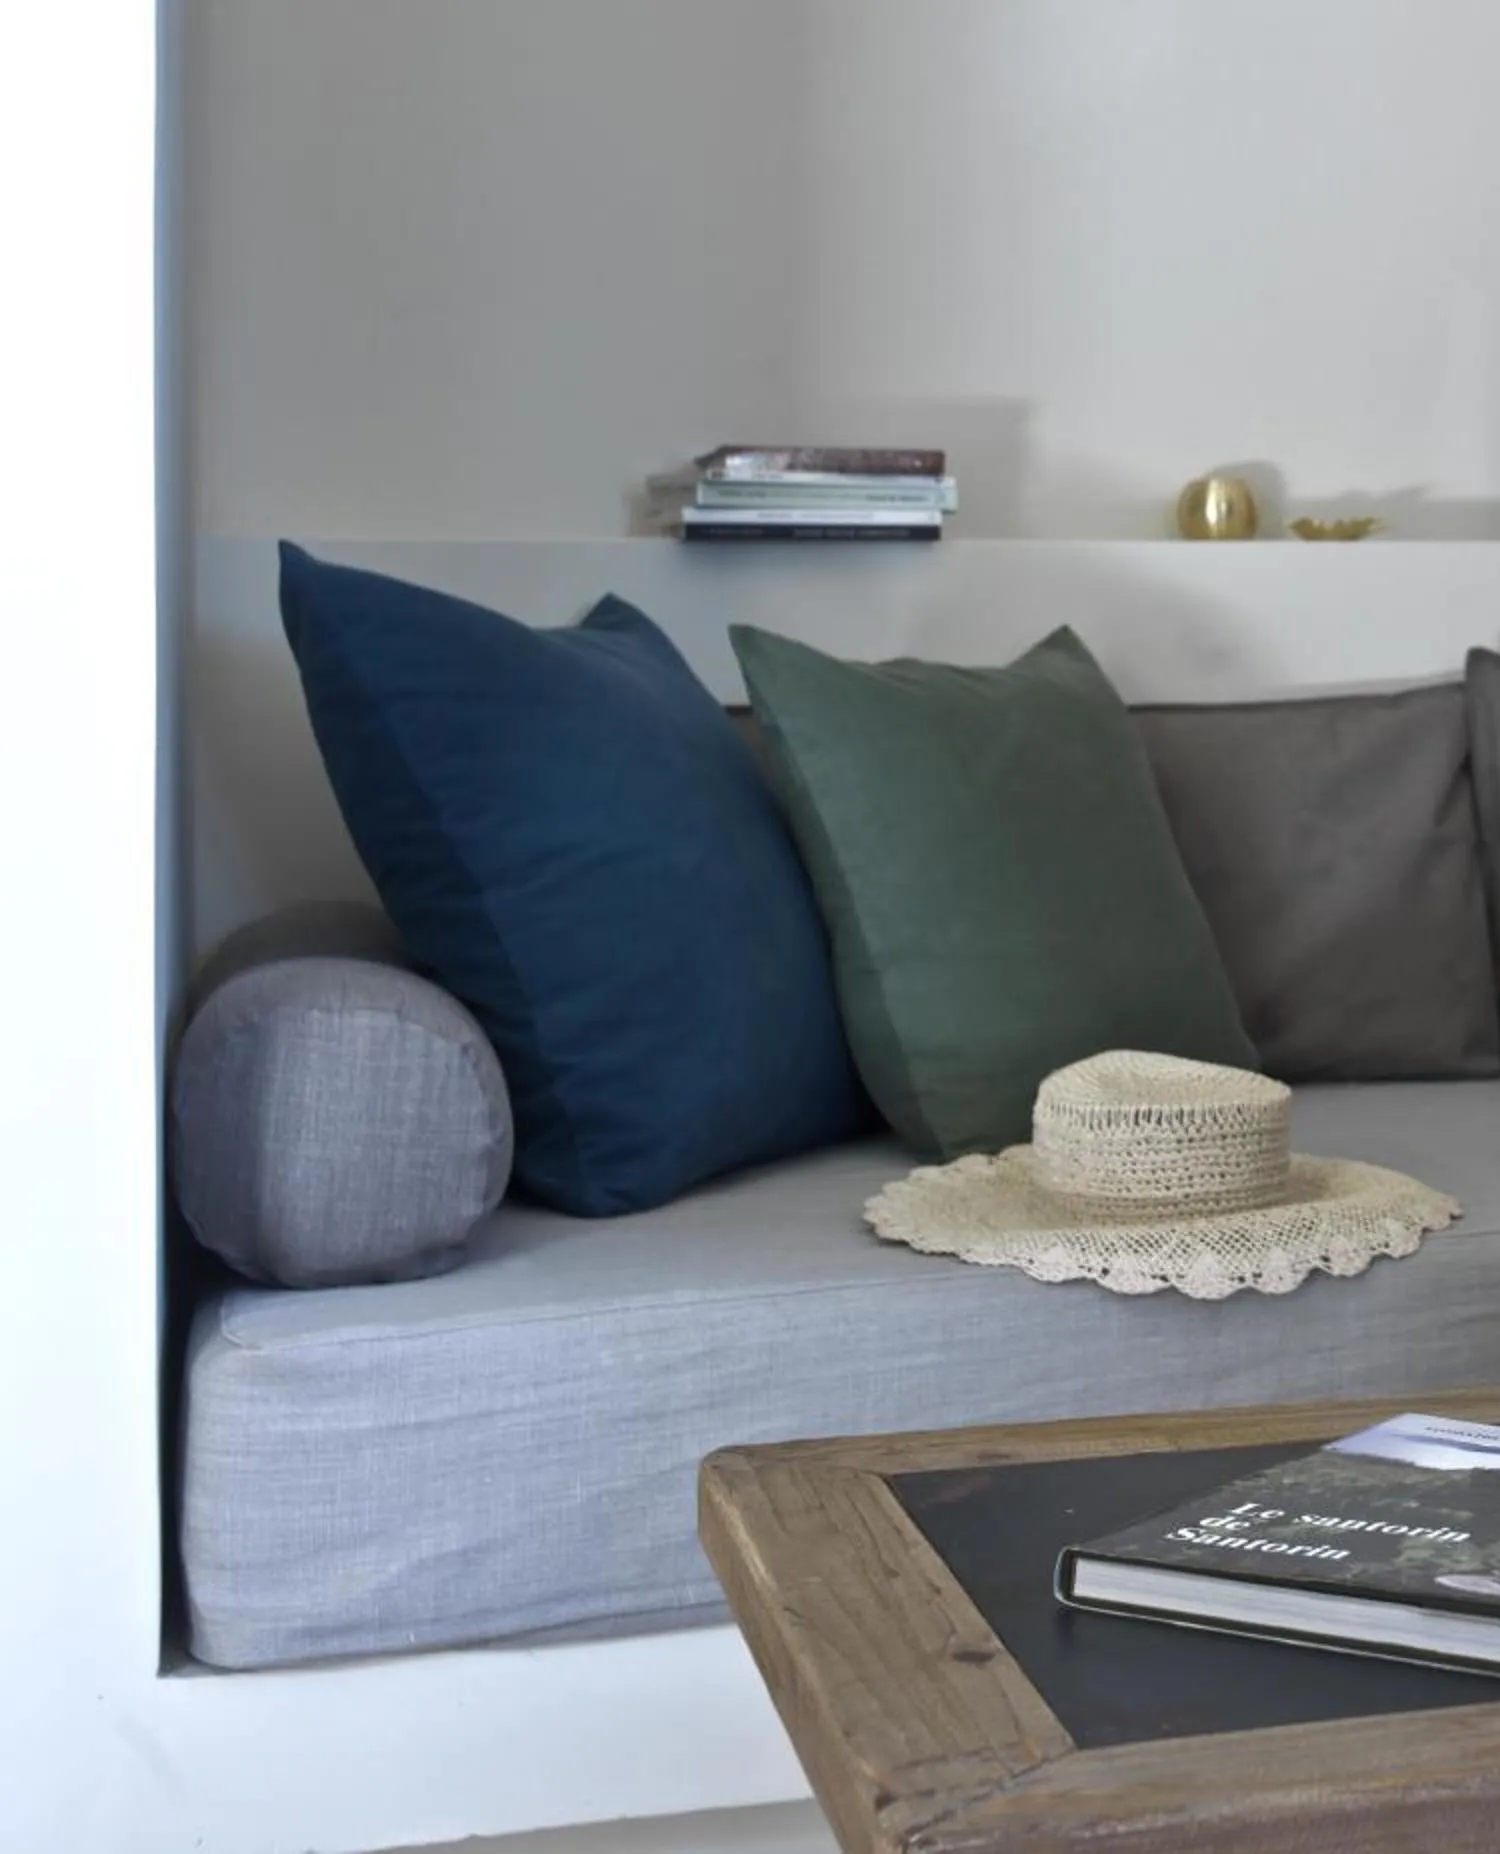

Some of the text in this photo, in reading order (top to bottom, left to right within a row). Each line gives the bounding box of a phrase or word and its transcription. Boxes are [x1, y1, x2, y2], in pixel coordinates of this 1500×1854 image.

[1199, 1515, 1252, 1531] de
[1229, 1502, 1472, 1543] Le santorin
[1165, 1526, 1350, 1560] Santorin
